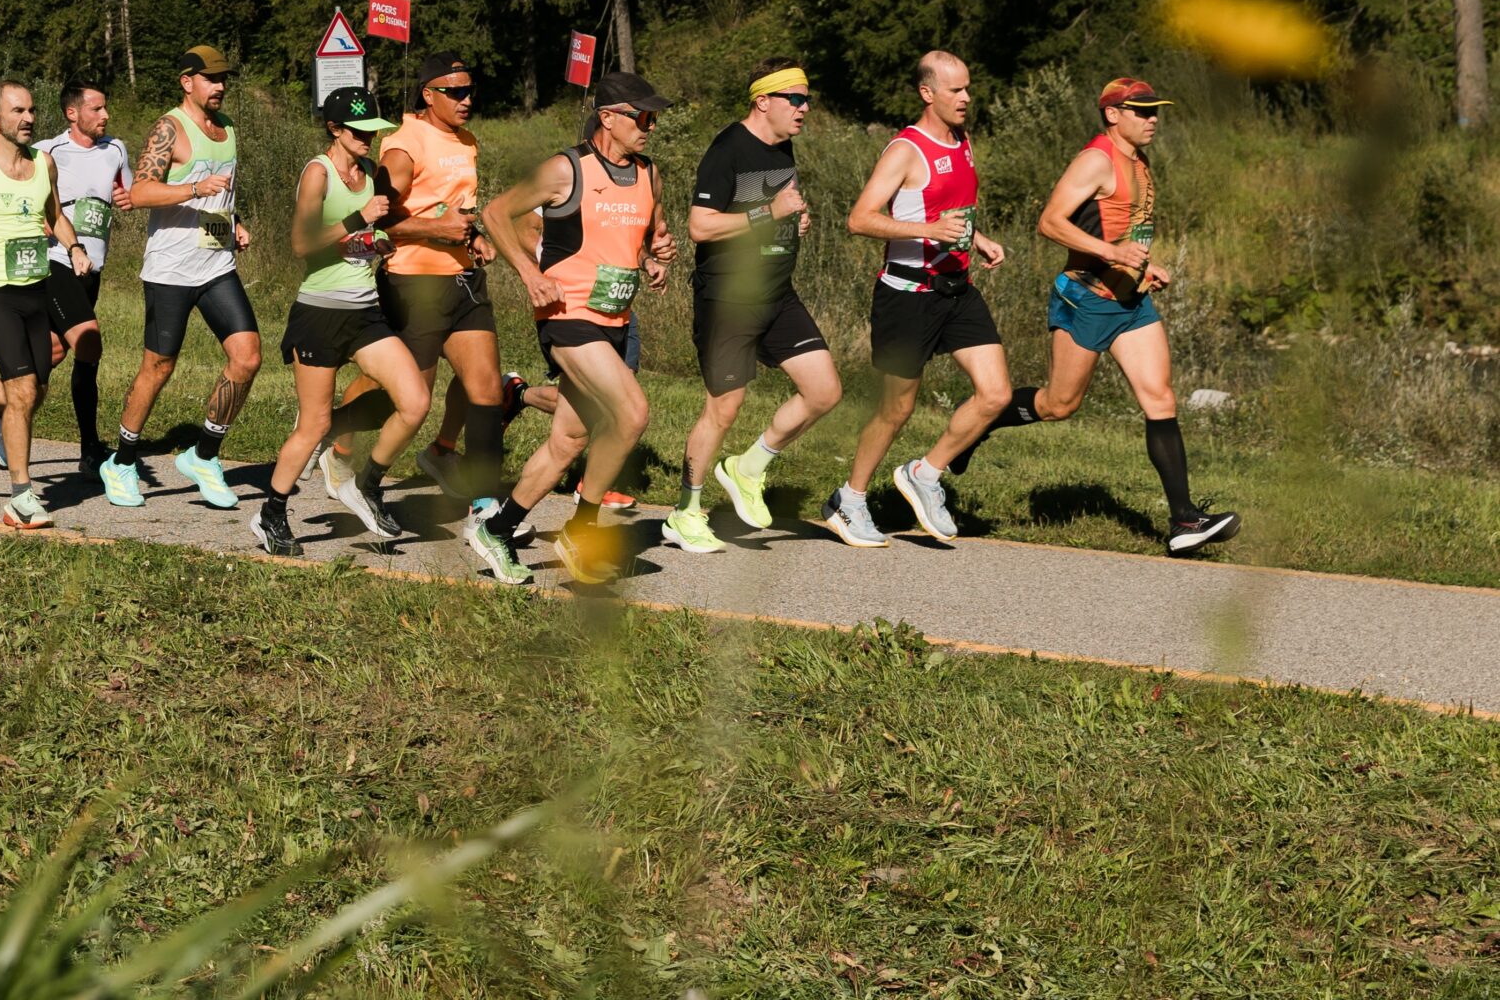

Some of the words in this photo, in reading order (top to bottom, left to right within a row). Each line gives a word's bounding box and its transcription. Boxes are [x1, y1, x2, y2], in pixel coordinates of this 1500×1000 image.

[371, 2, 397, 16] PACERS
[595, 202, 637, 214] PACERS
[84, 210, 104, 226] 256
[774, 224, 794, 240] 228
[16, 249, 38, 265] 152
[608, 282, 635, 300] 303
